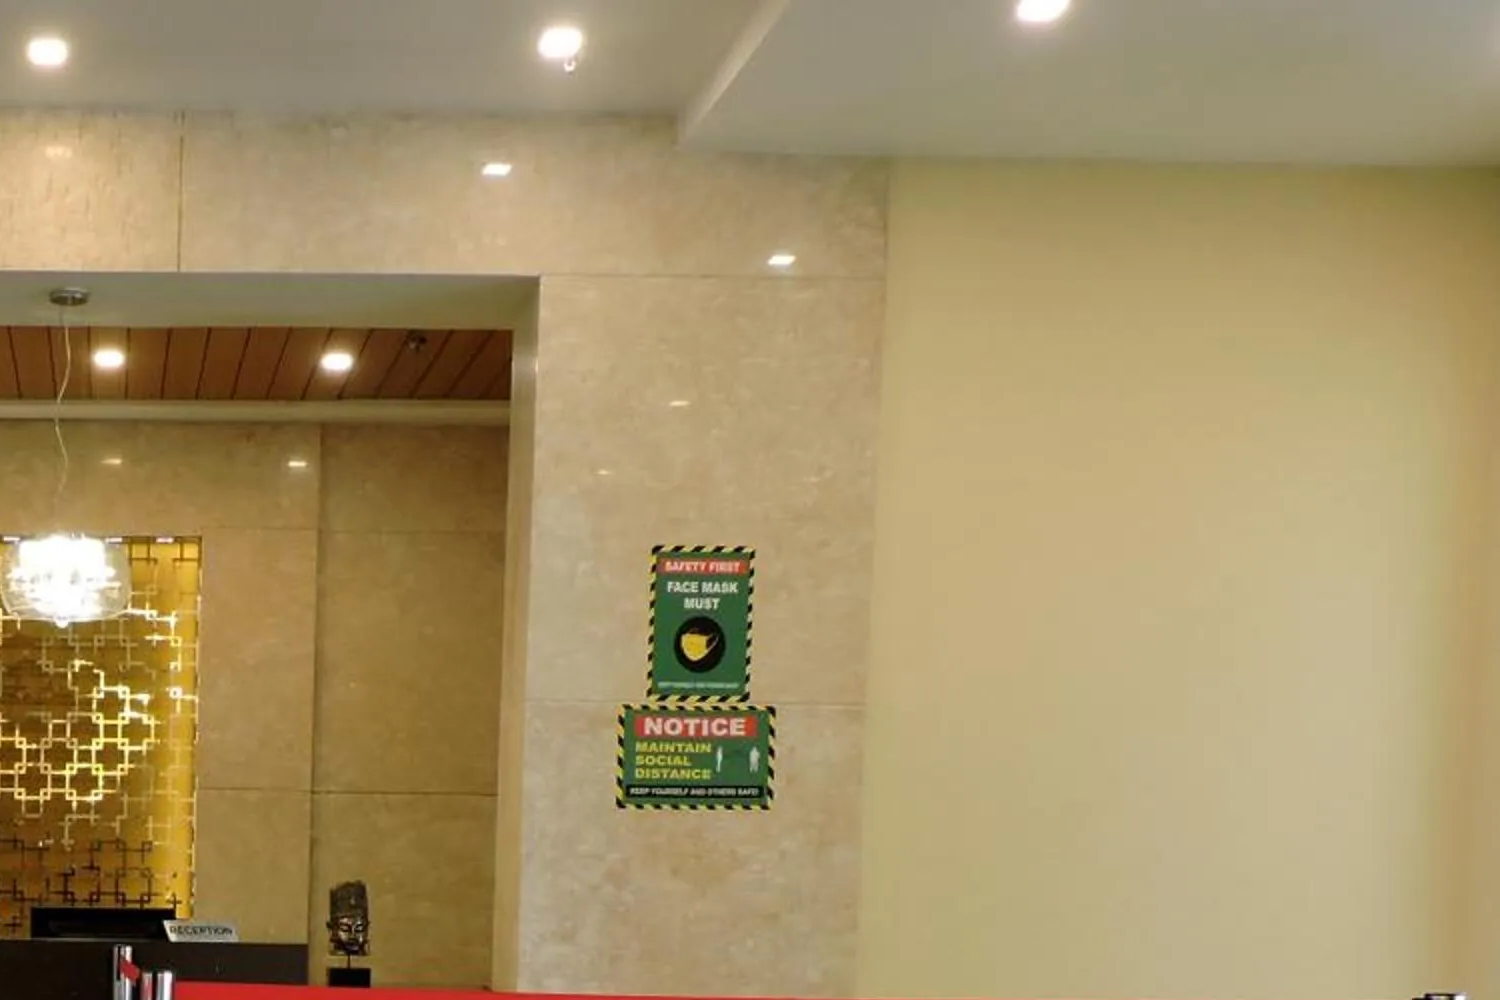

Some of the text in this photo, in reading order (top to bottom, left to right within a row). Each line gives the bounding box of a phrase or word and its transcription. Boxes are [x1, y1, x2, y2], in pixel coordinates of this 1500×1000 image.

[666, 581, 739, 593] FACE MASK
[683, 598, 720, 610] MUST
[643, 717, 746, 737] NOTICE
[635, 742, 712, 753] MAINTAIN
[635, 755, 692, 767] SOCIAL
[635, 768, 712, 780] DISTANCE
[169, 925, 233, 937] RECEPTION
